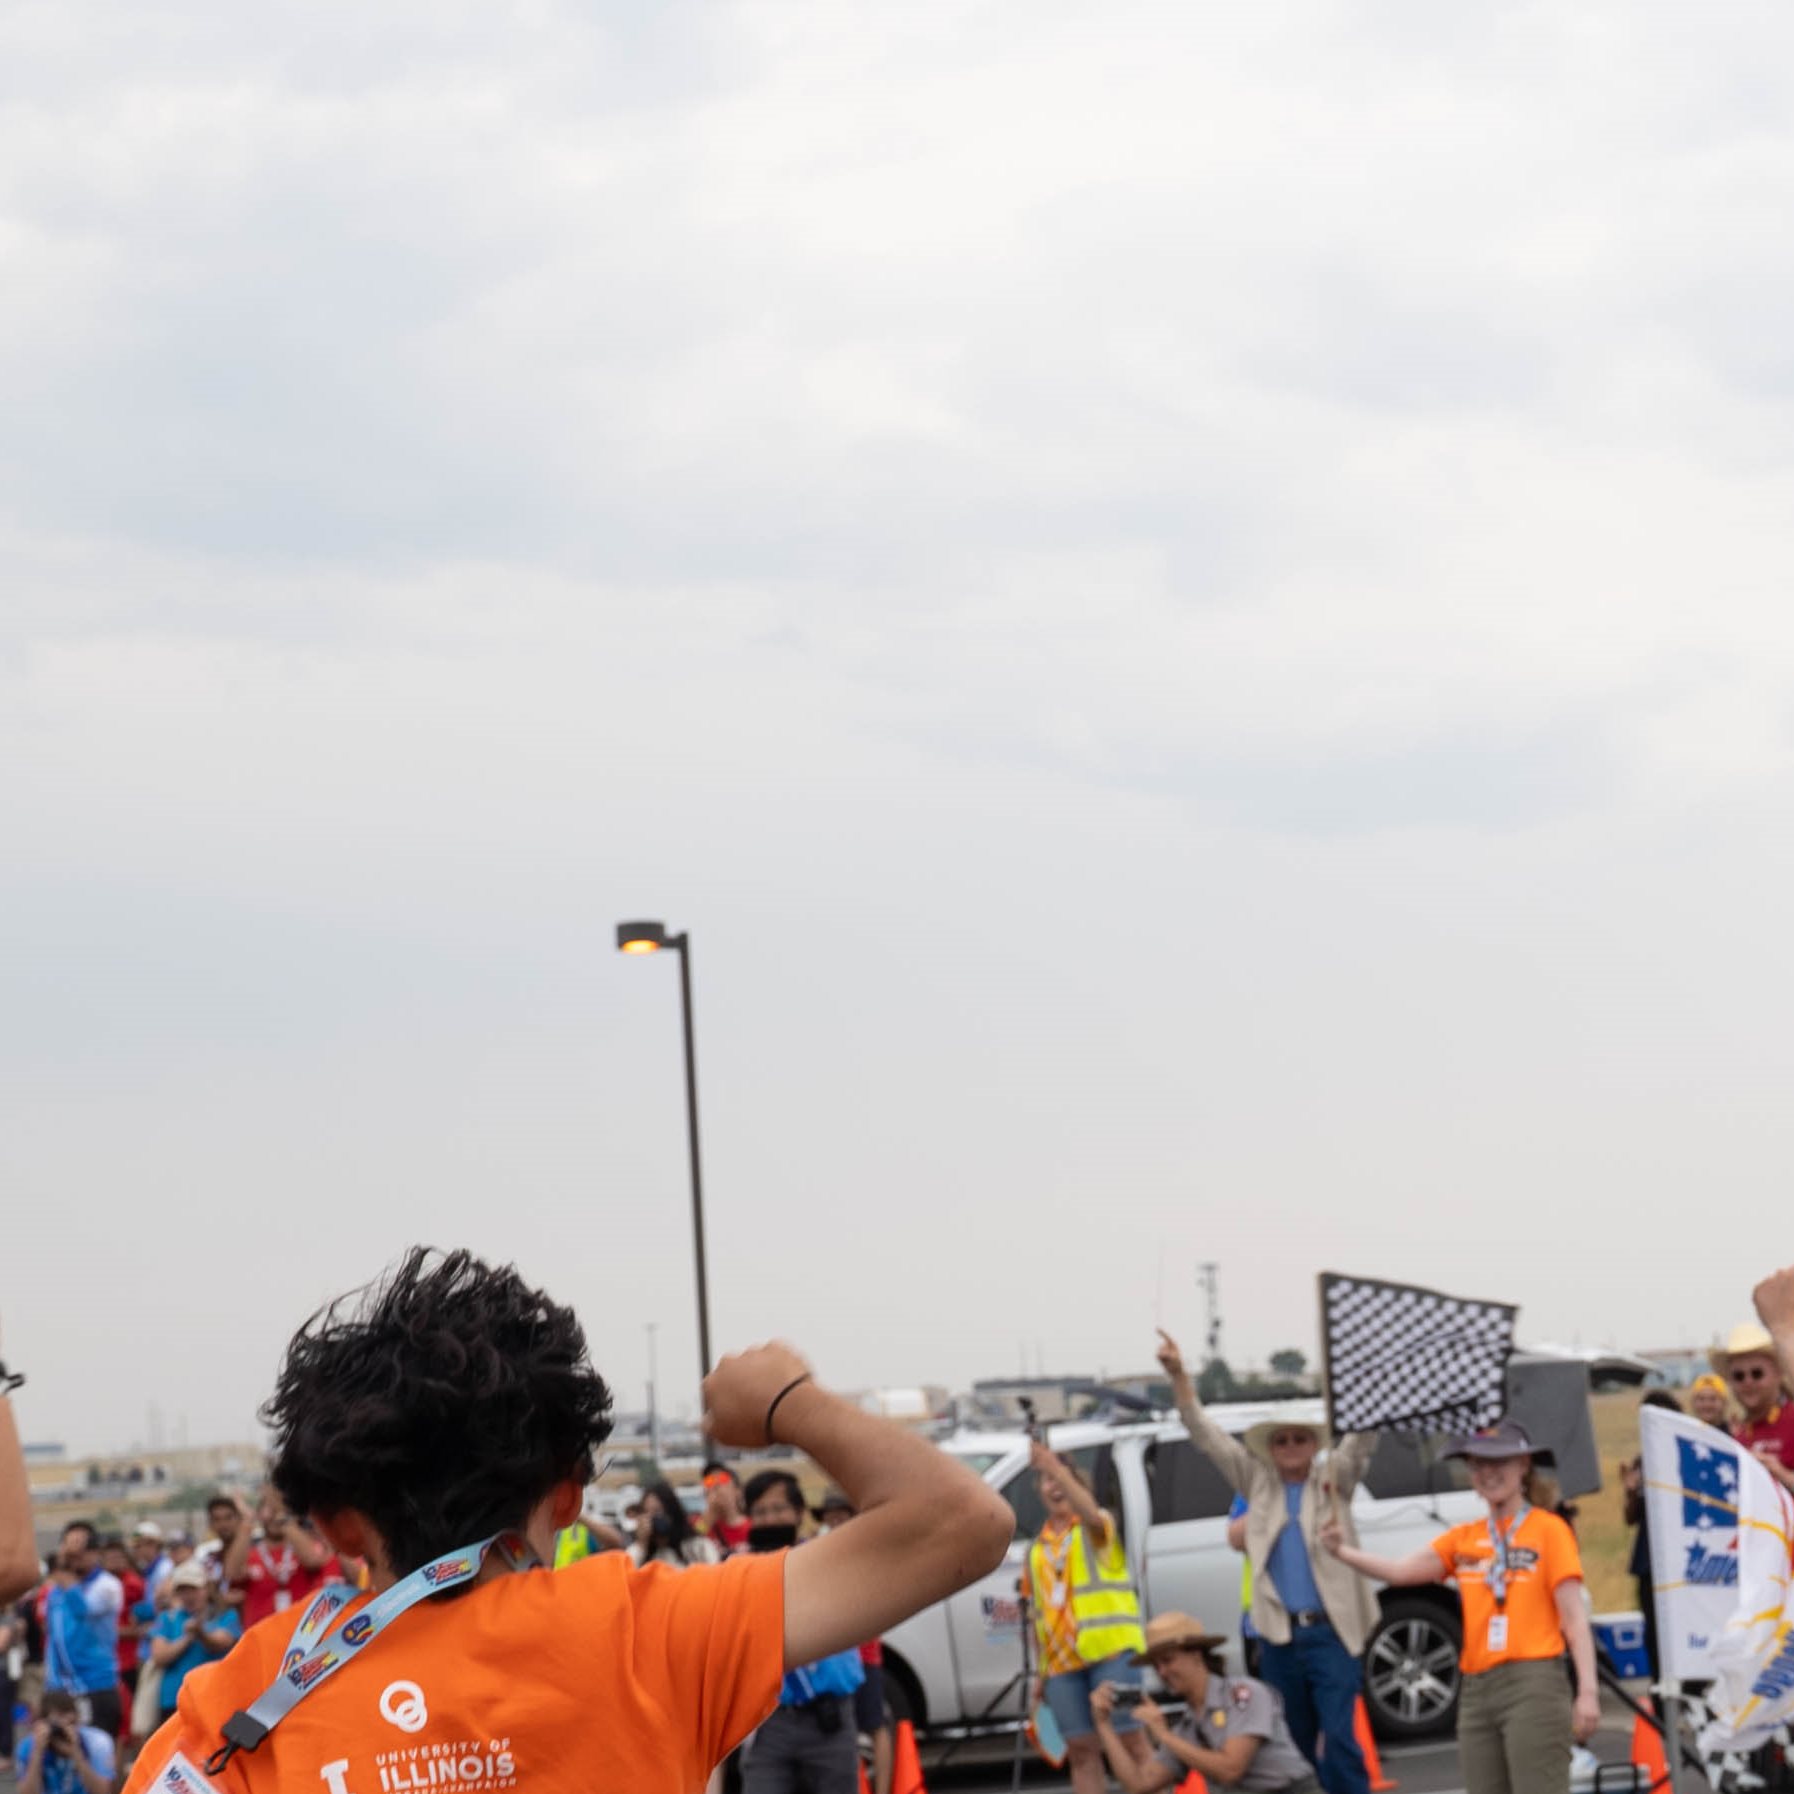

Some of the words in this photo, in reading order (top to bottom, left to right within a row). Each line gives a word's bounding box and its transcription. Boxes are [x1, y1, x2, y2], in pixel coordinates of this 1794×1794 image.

[375, 1741, 481, 1766] UNIVERSITY
[489, 1738, 511, 1752] OF
[378, 1751, 516, 1793] ILLINOIS
